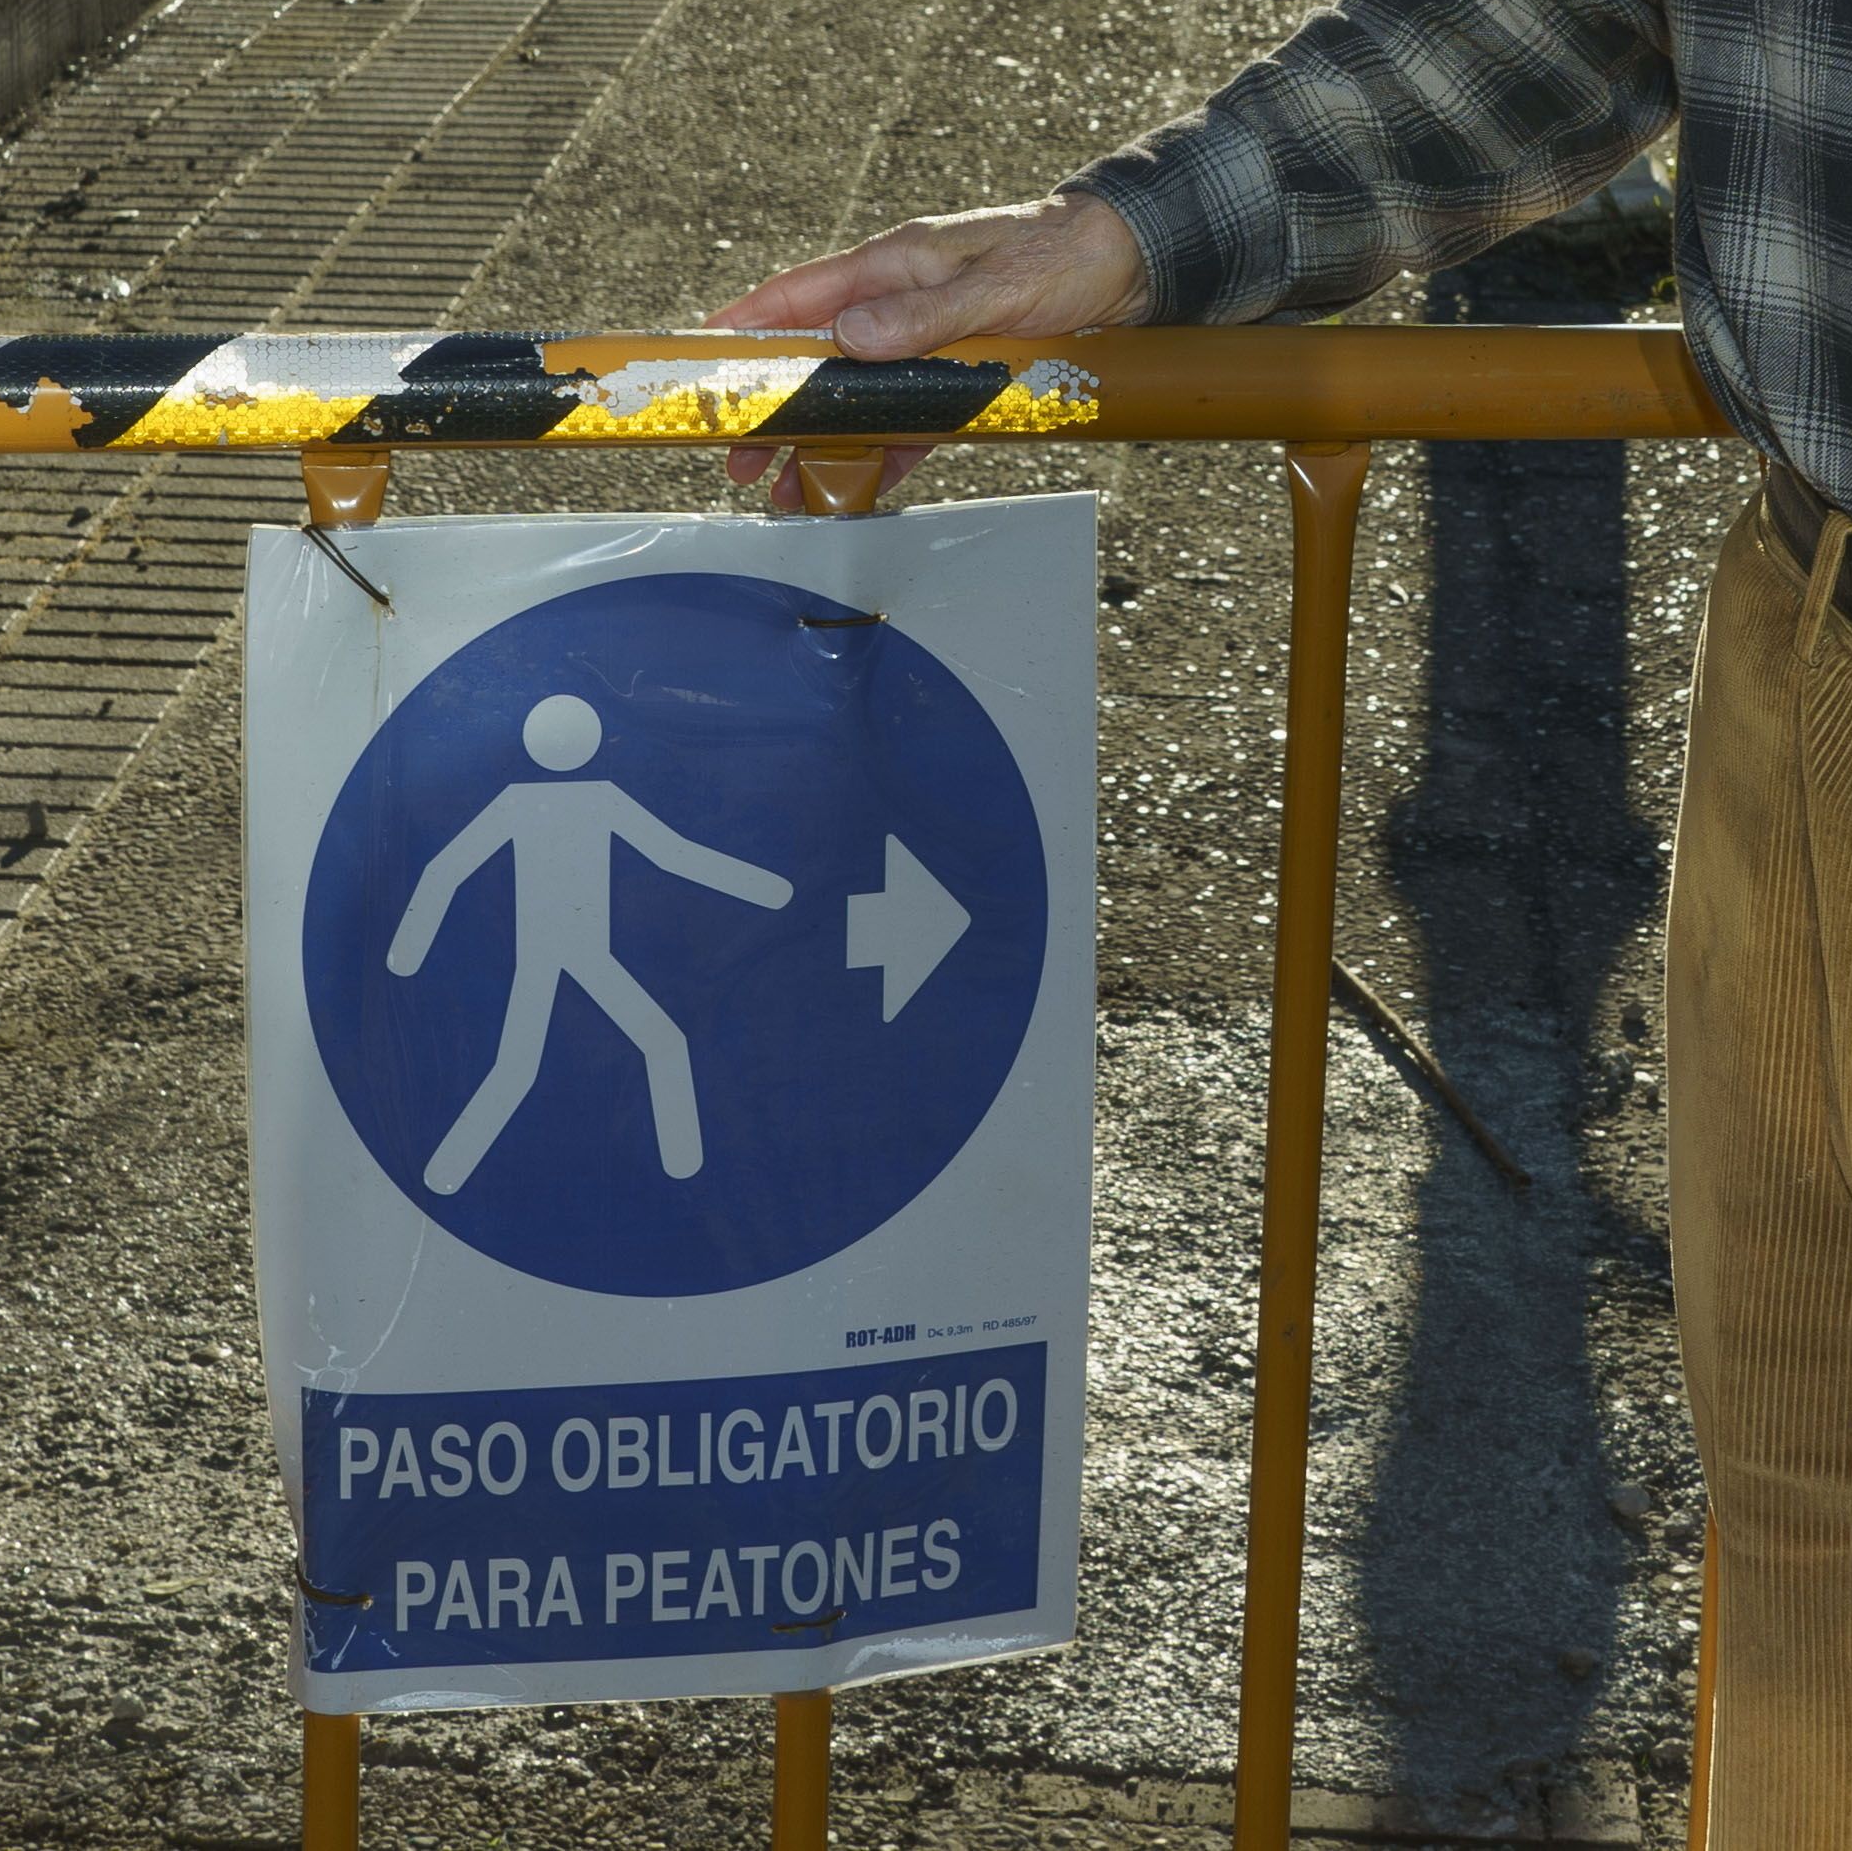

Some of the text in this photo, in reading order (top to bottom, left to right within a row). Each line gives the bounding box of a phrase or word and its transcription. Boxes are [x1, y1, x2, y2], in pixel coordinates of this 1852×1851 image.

[845, 1324, 916, 1348] ROT-ADH
[982, 1320, 999, 1332] RD
[1001, 1315, 1038, 1329] 485/97
[338, 1378, 1019, 1499] PASO OBLIGATORIO
[395, 1517, 963, 1632] PARA PEATONES
